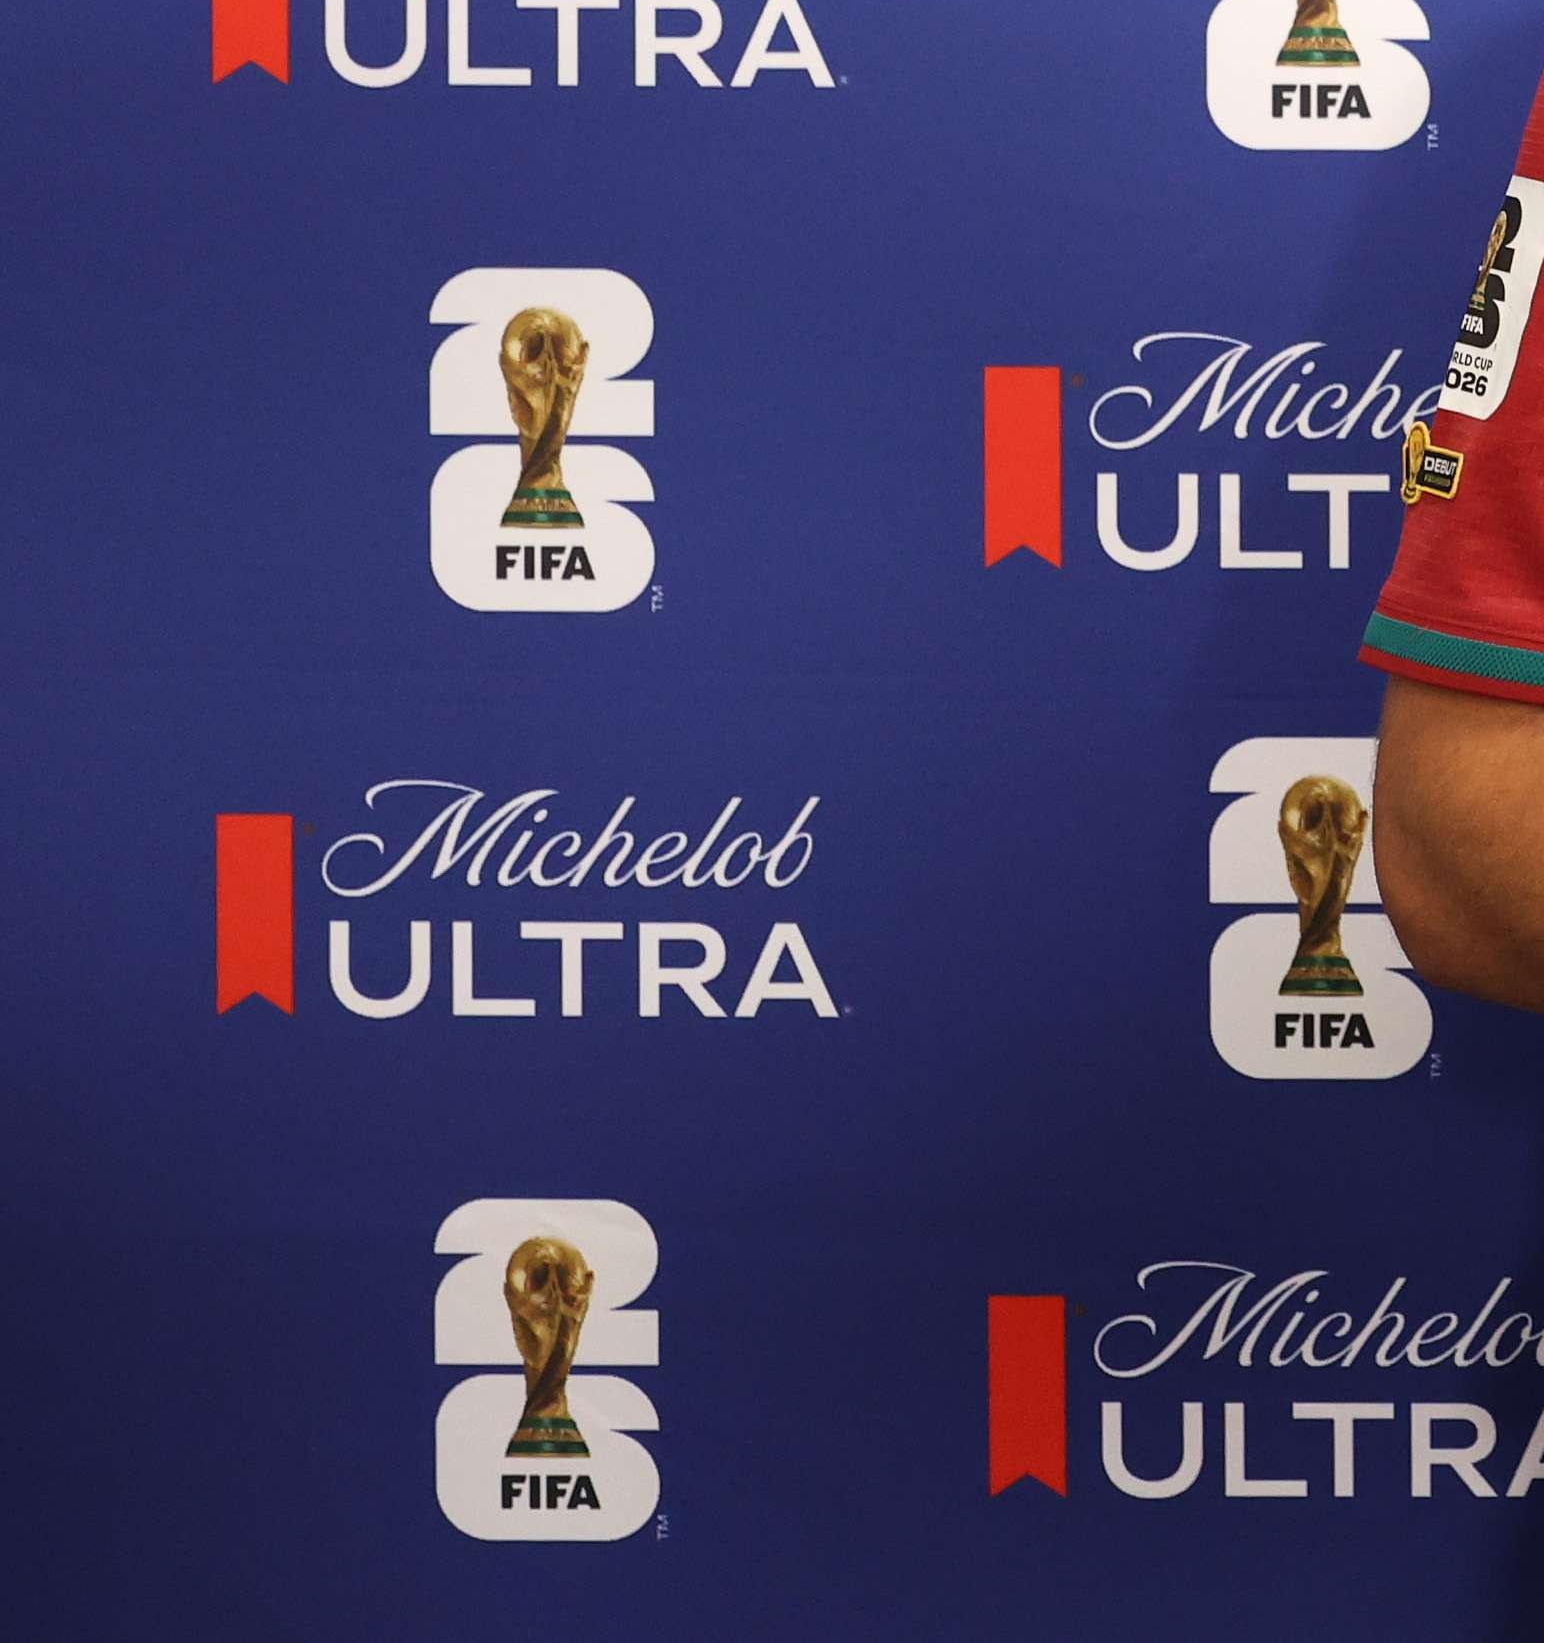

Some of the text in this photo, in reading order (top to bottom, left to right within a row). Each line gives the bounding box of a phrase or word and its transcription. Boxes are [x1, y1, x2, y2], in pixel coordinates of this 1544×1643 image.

[1271, 83, 1372, 119] FIFA
[1460, 313, 1485, 336] FIFA
[1445, 367, 1489, 397] 026
[1474, 356, 1494, 373] CUP
[1088, 331, 1439, 450] Miche
[1096, 472, 1391, 572] ULT
[495, 545, 596, 581] FIFA
[321, 779, 821, 898] Michelob
[329, 920, 839, 1019] ULTRA
[1274, 1012, 1376, 1049] FIFA
[500, 1474, 601, 1510] FIFA
